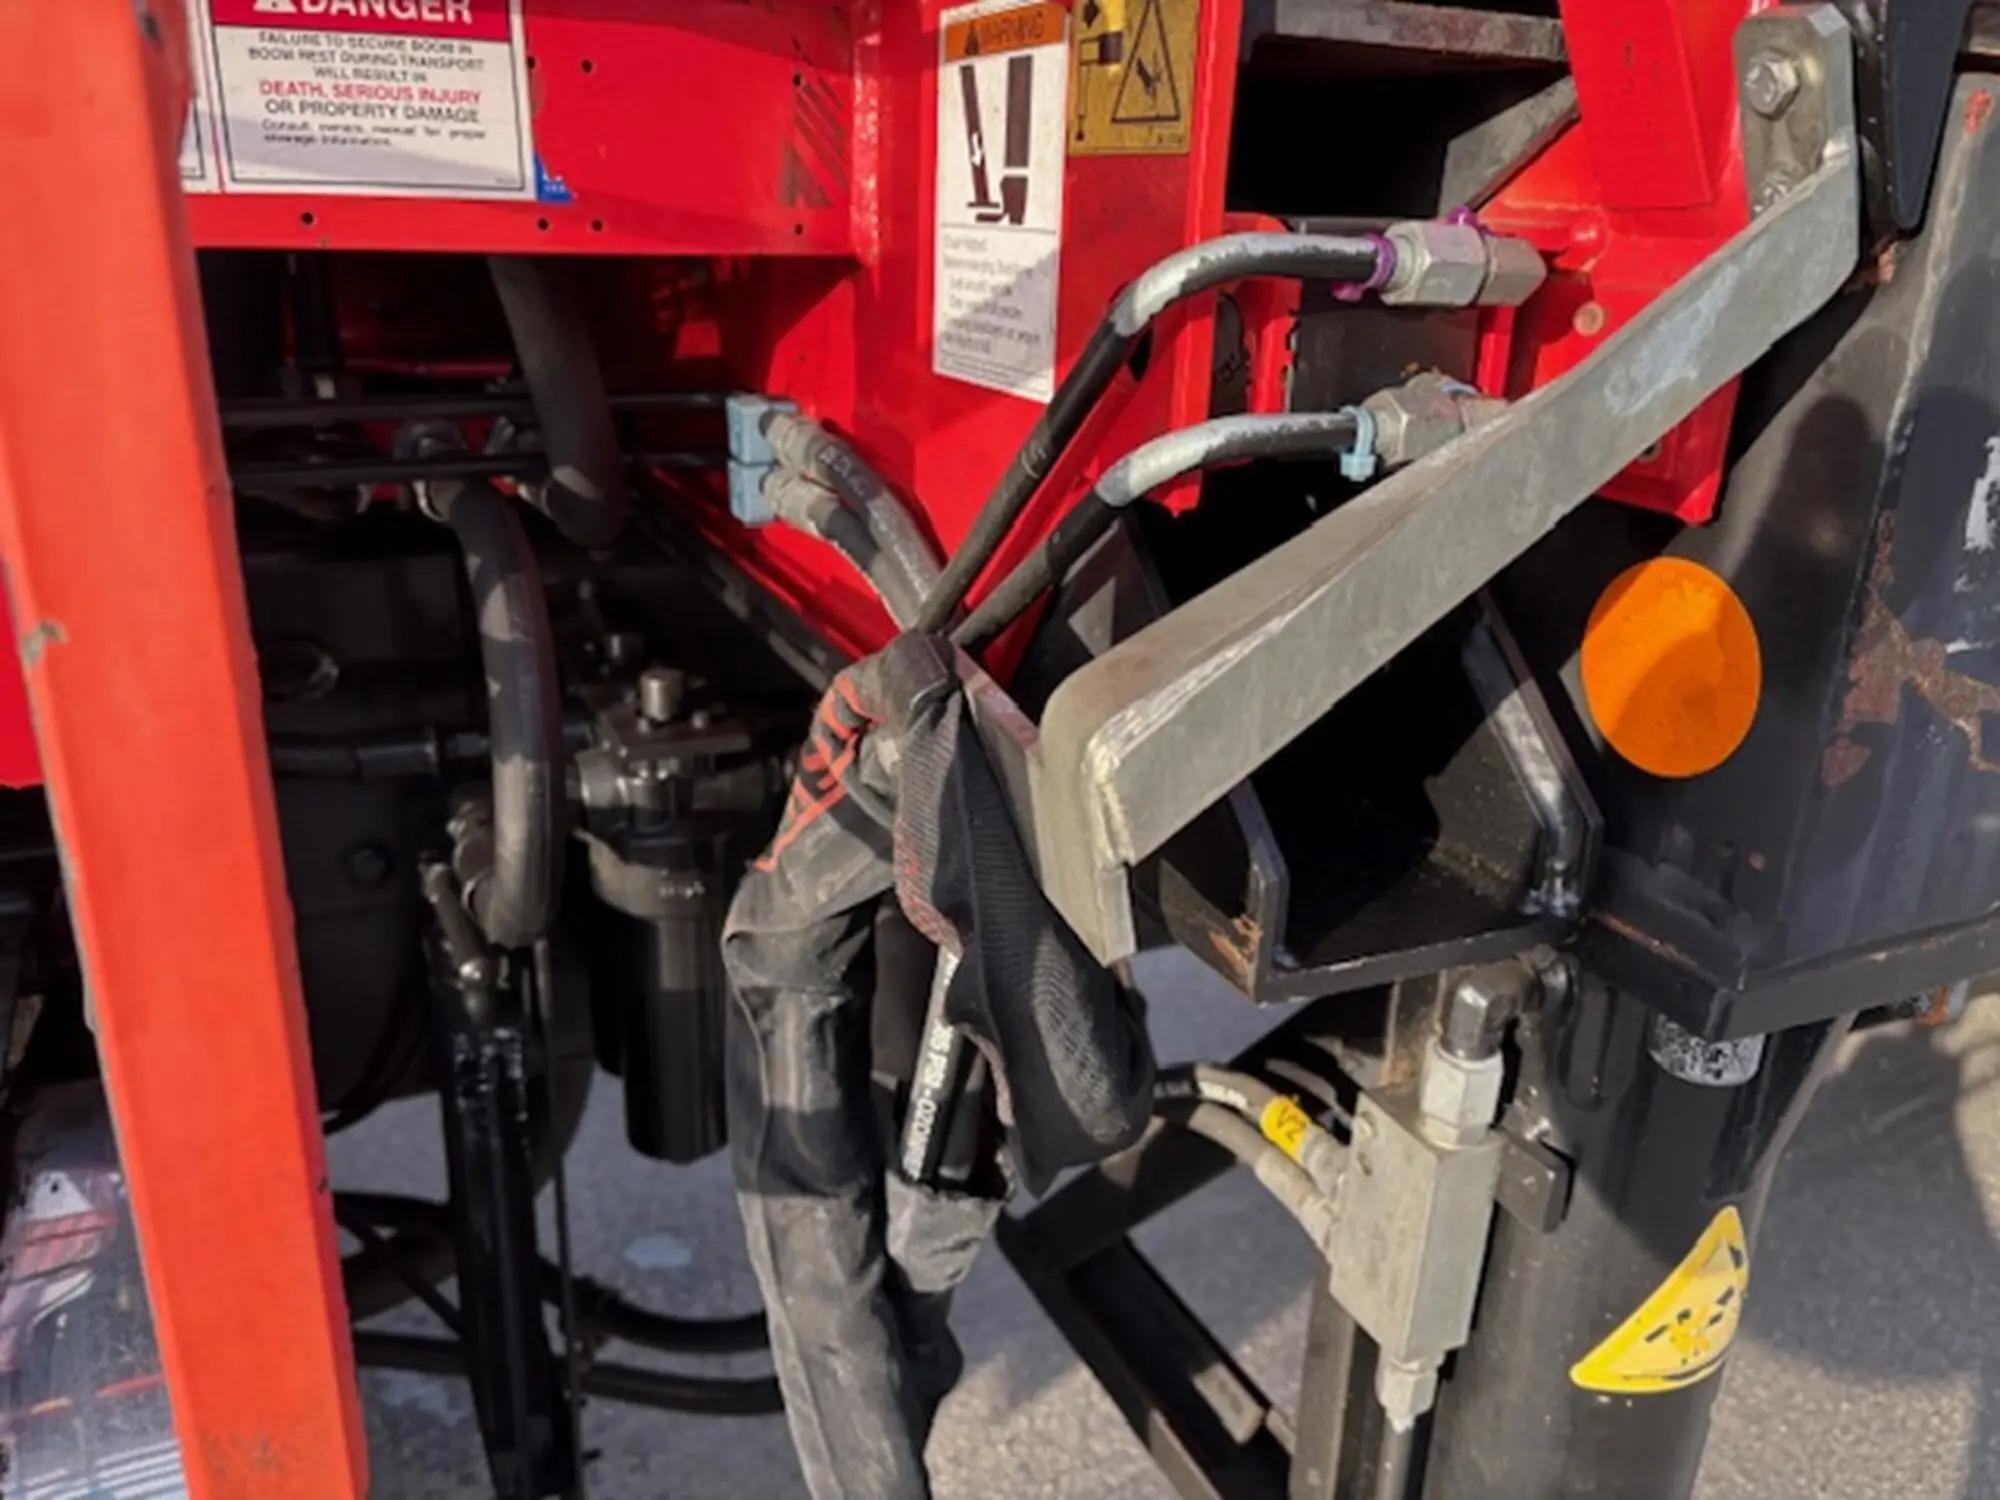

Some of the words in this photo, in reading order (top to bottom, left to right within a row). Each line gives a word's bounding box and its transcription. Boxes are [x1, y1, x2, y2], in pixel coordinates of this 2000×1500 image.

[301, 0, 473, 24] DANGER
[259, 32, 319, 46] FAILURE
[326, 35, 344, 47] TO
[347, 36, 408, 50] SECURE
[411, 39, 453, 53] BOOM
[457, 42, 472, 54] IN
[249, 48, 294, 61] BOOM
[299, 50, 335, 63] REST
[340, 51, 397, 67] DURING
[401, 56, 484, 71] TRANSPORT
[314, 67, 348, 80] WILL
[353, 68, 408, 82] RESULT
[412, 72, 427, 82] IN
[260, 81, 328, 98] DEATH,
[332, 84, 414, 101] SERIOUS
[417, 87, 481, 104] INJURY
[265, 99, 294, 114] OR
[299, 100, 398, 119] PROPERTY
